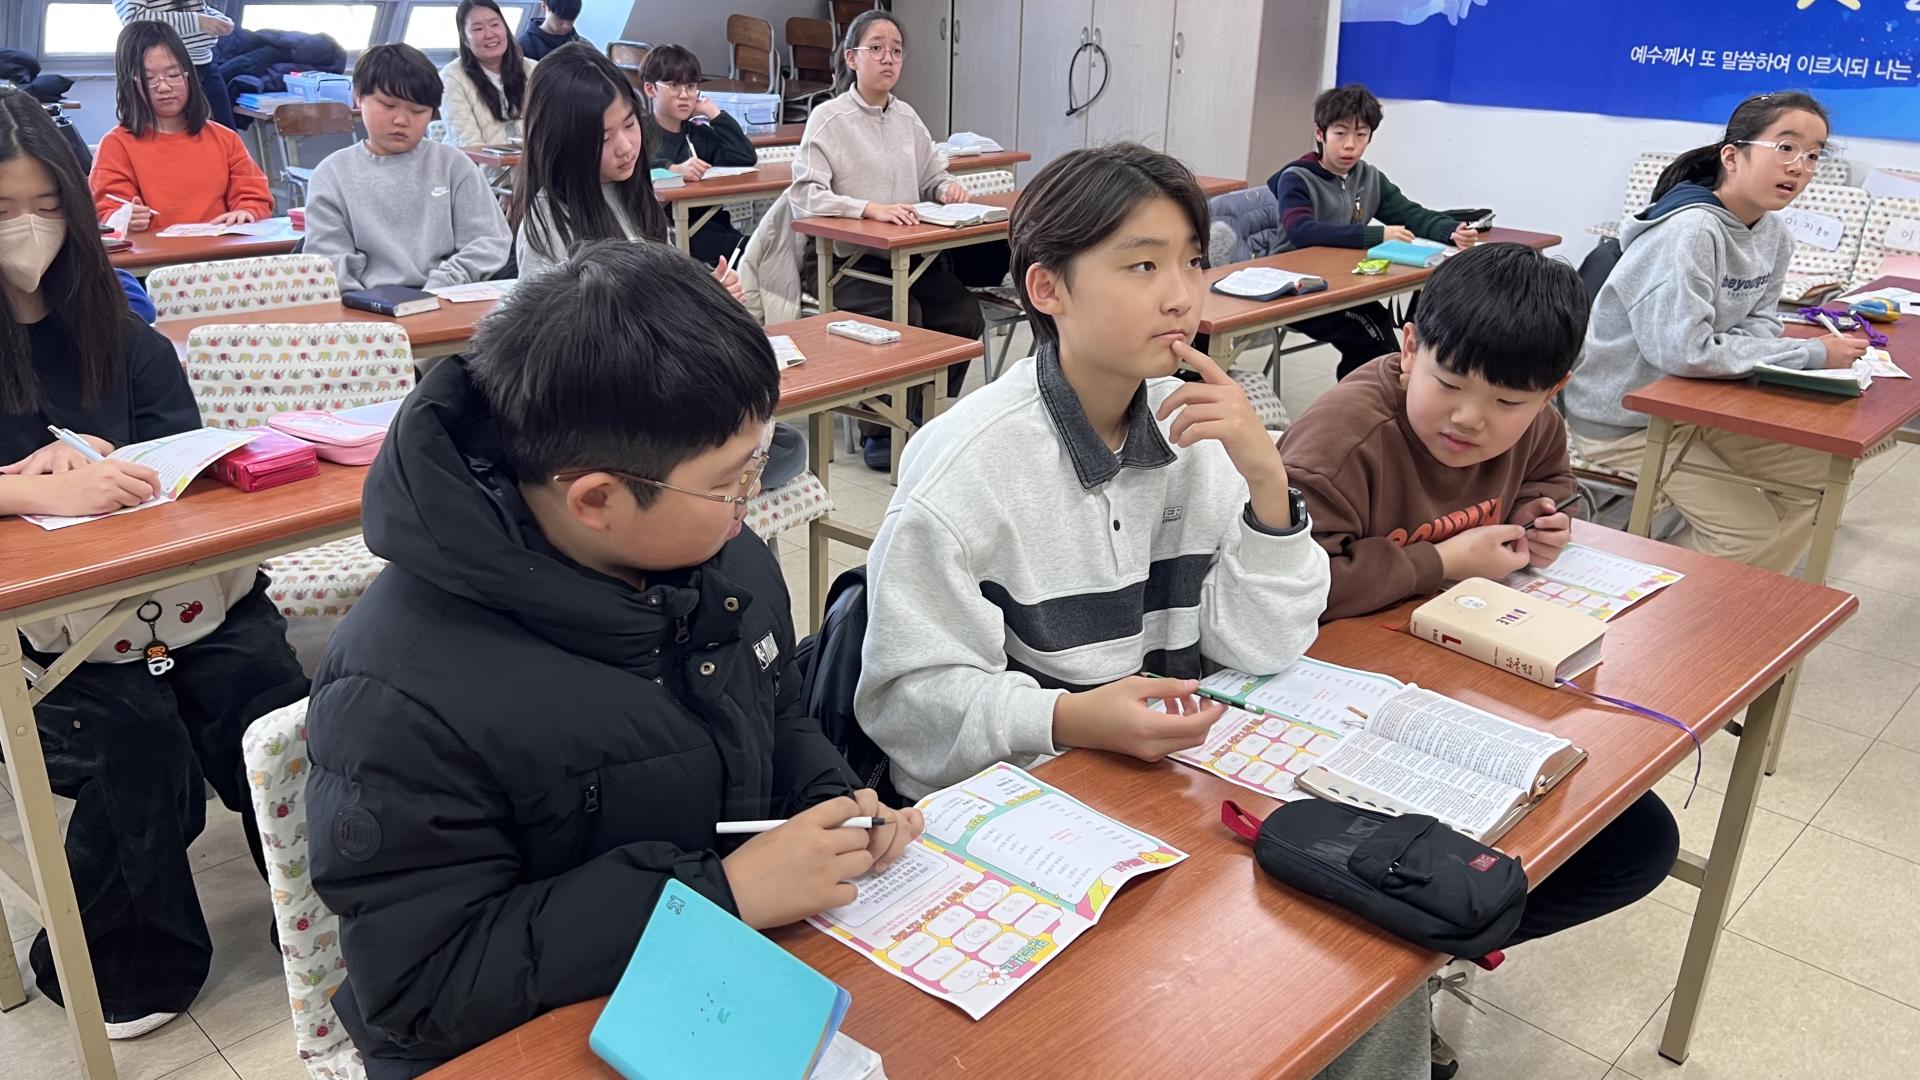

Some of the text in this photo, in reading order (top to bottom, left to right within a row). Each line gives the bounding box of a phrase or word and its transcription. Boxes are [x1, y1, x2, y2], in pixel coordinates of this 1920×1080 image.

[1630, 45, 1912, 81] 예수께서 또 말씀하여 이르시되 나는
[1495, 608, 1528, 625] BIBLE
